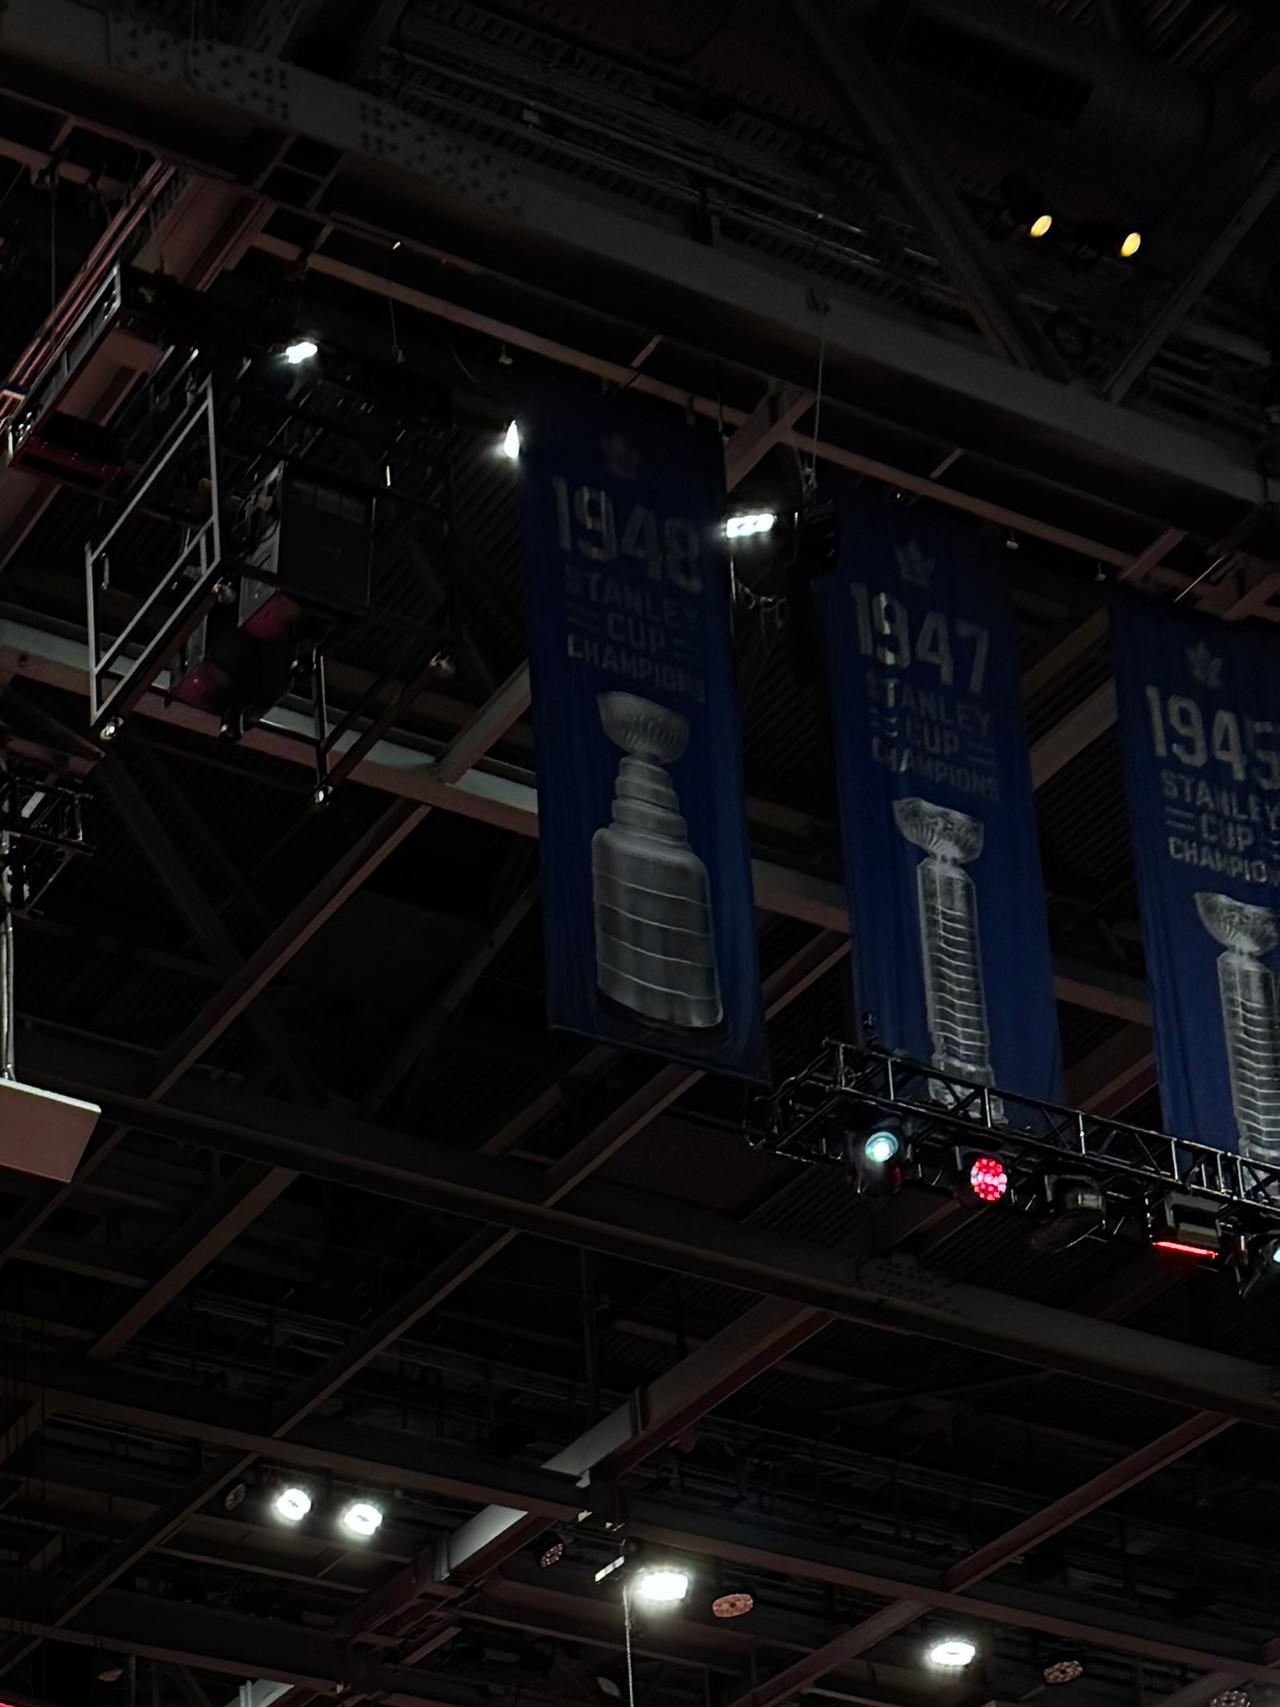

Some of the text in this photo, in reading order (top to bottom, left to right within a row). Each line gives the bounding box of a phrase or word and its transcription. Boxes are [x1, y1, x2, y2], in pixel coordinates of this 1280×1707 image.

[552, 475, 702, 593] 1948
[850, 582, 989, 693] 1947
[1146, 686, 1280, 790] 1945
[1201, 813, 1254, 851] CUP
